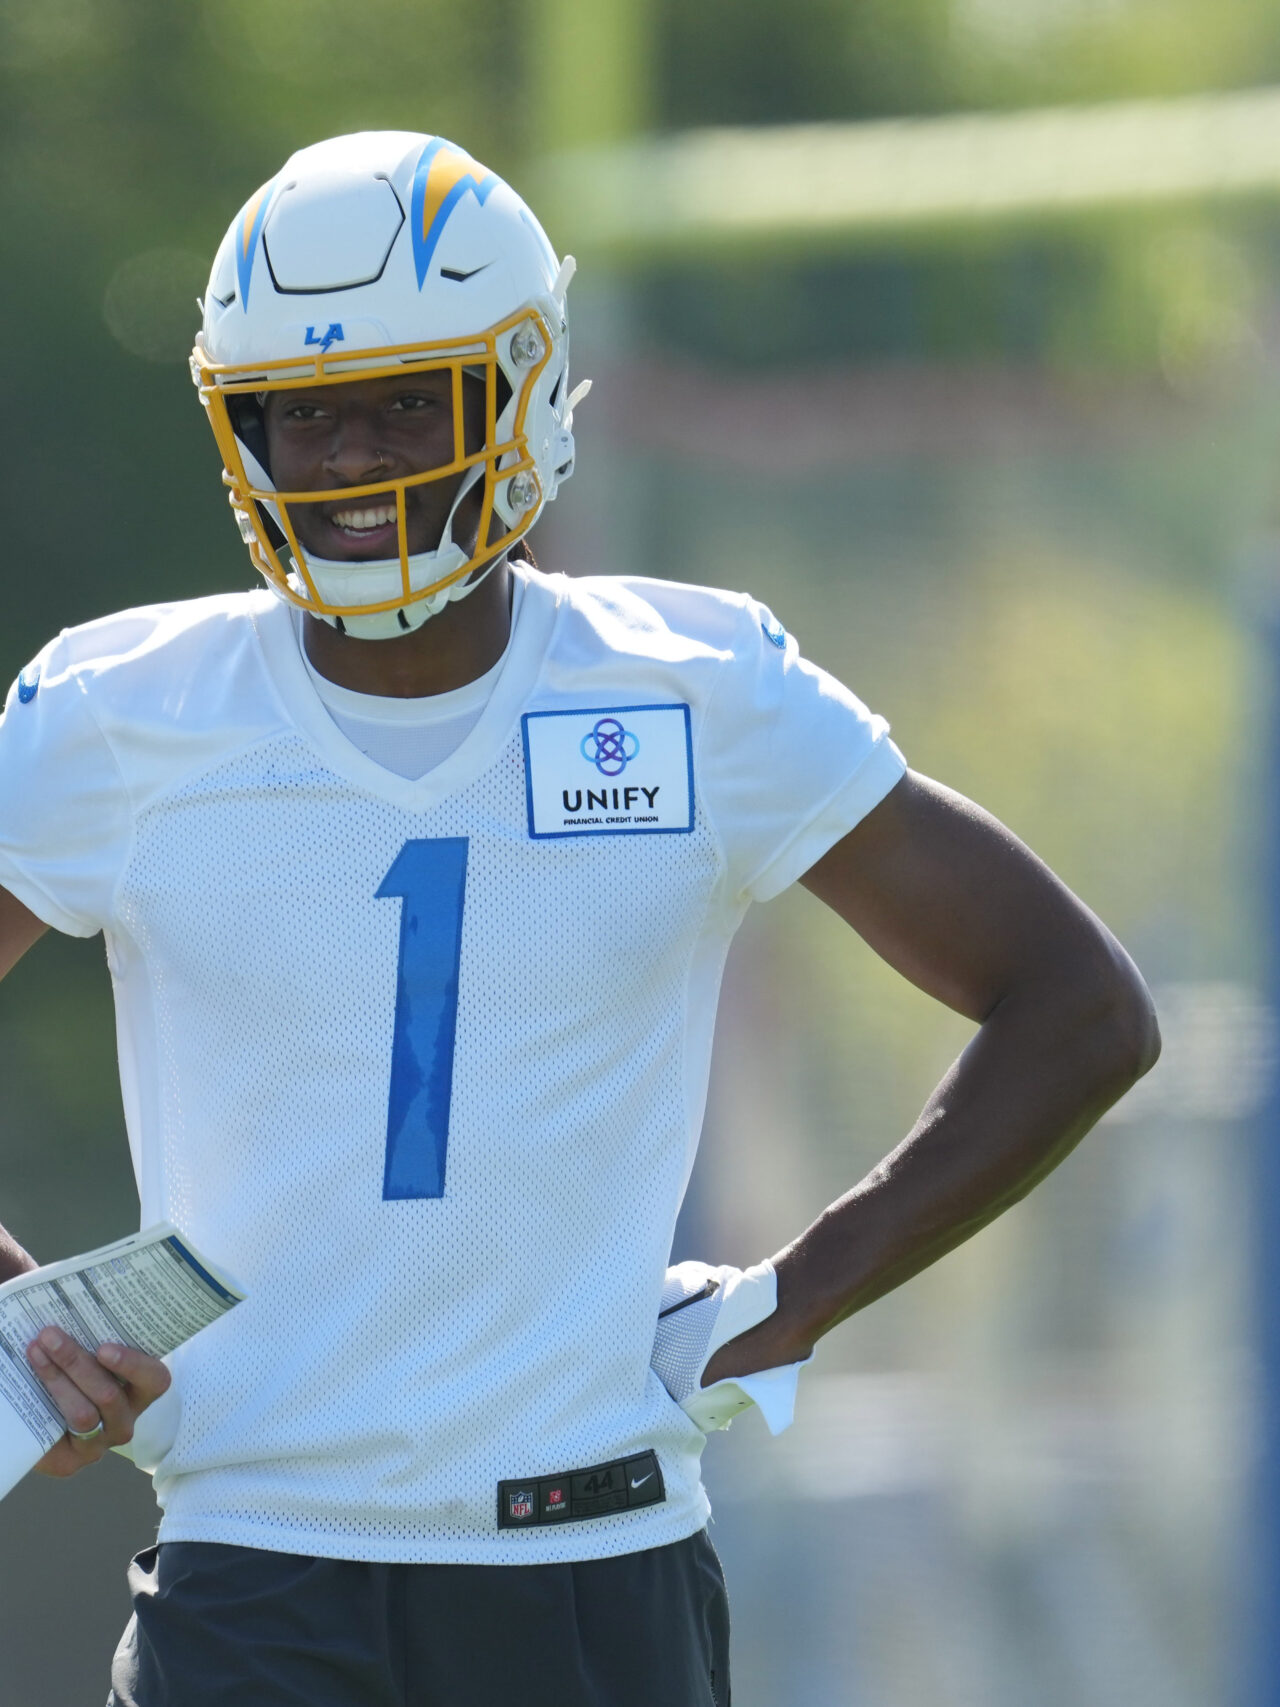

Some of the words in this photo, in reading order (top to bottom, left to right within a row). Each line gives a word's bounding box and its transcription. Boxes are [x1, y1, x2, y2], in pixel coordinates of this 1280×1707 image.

[304, 323, 345, 354] LA
[562, 786, 660, 812] UNIFY
[563, 817, 603, 826] FINANCIAL
[605, 816, 631, 824] CREDIT
[634, 815, 659, 823] UNION
[374, 836, 470, 1200] 1
[513, 1503, 530, 1516] NFL
